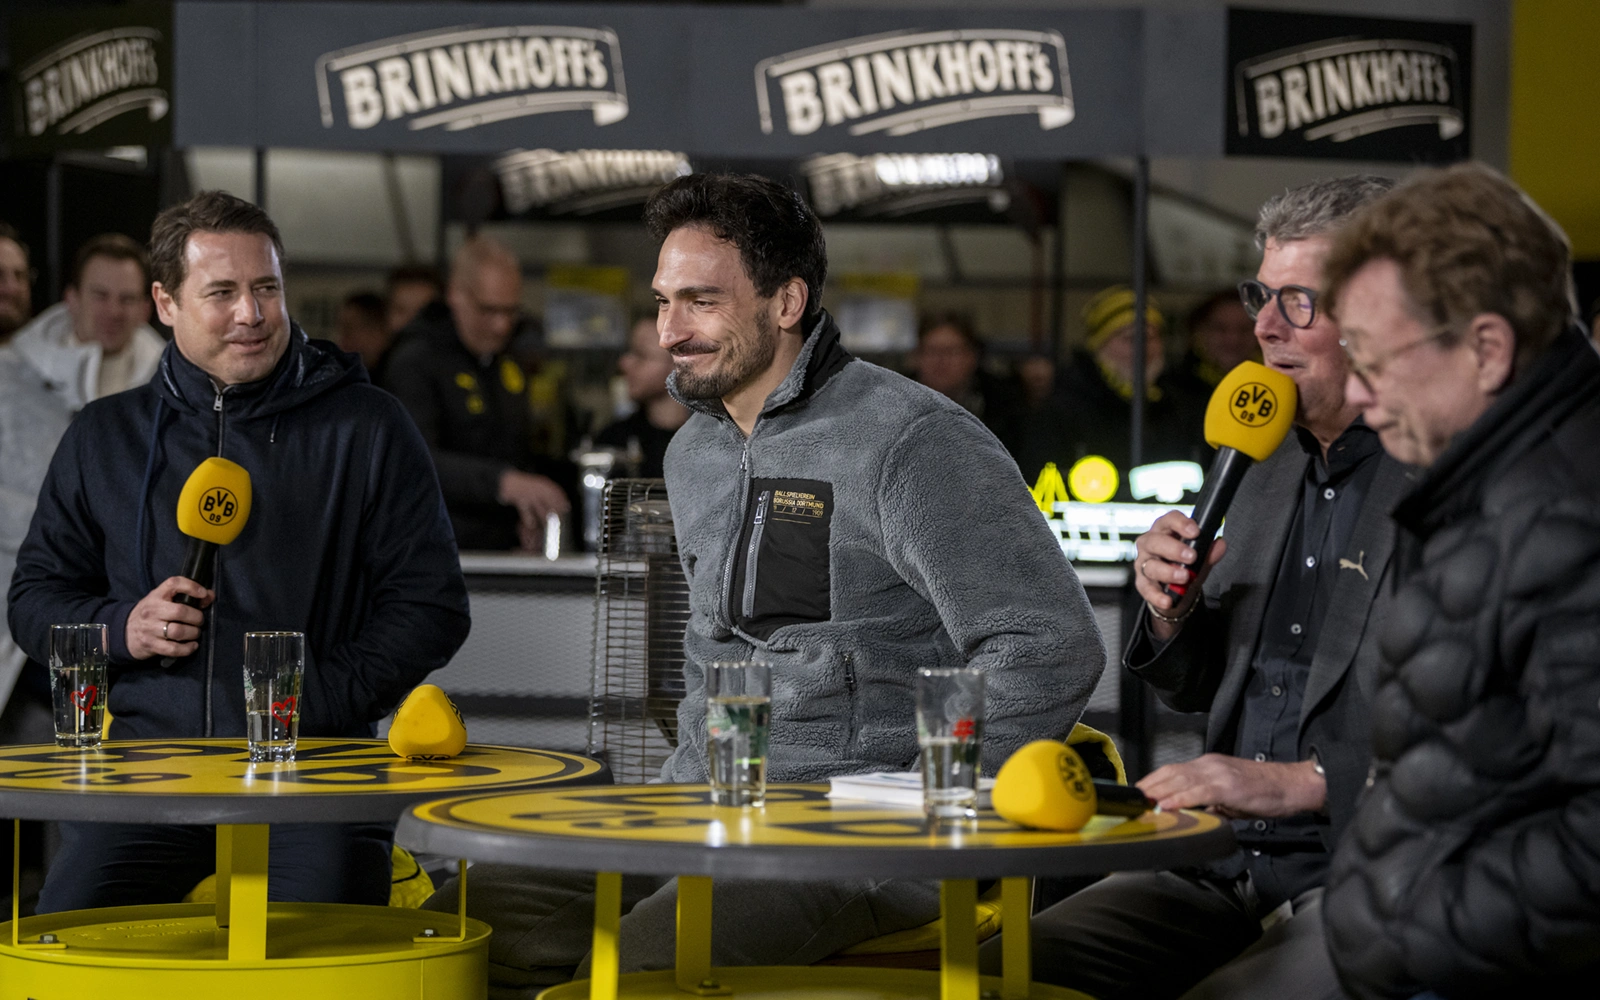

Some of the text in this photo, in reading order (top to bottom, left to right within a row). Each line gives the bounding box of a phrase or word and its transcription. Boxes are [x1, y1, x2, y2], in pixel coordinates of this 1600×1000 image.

[1235, 385, 1273, 418] BVB
[1240, 410, 1256, 423] 09
[203, 490, 235, 517] BVB
[773, 497, 824, 508] BORUSSIA DORTMUND
[209, 513, 222, 523] 09
